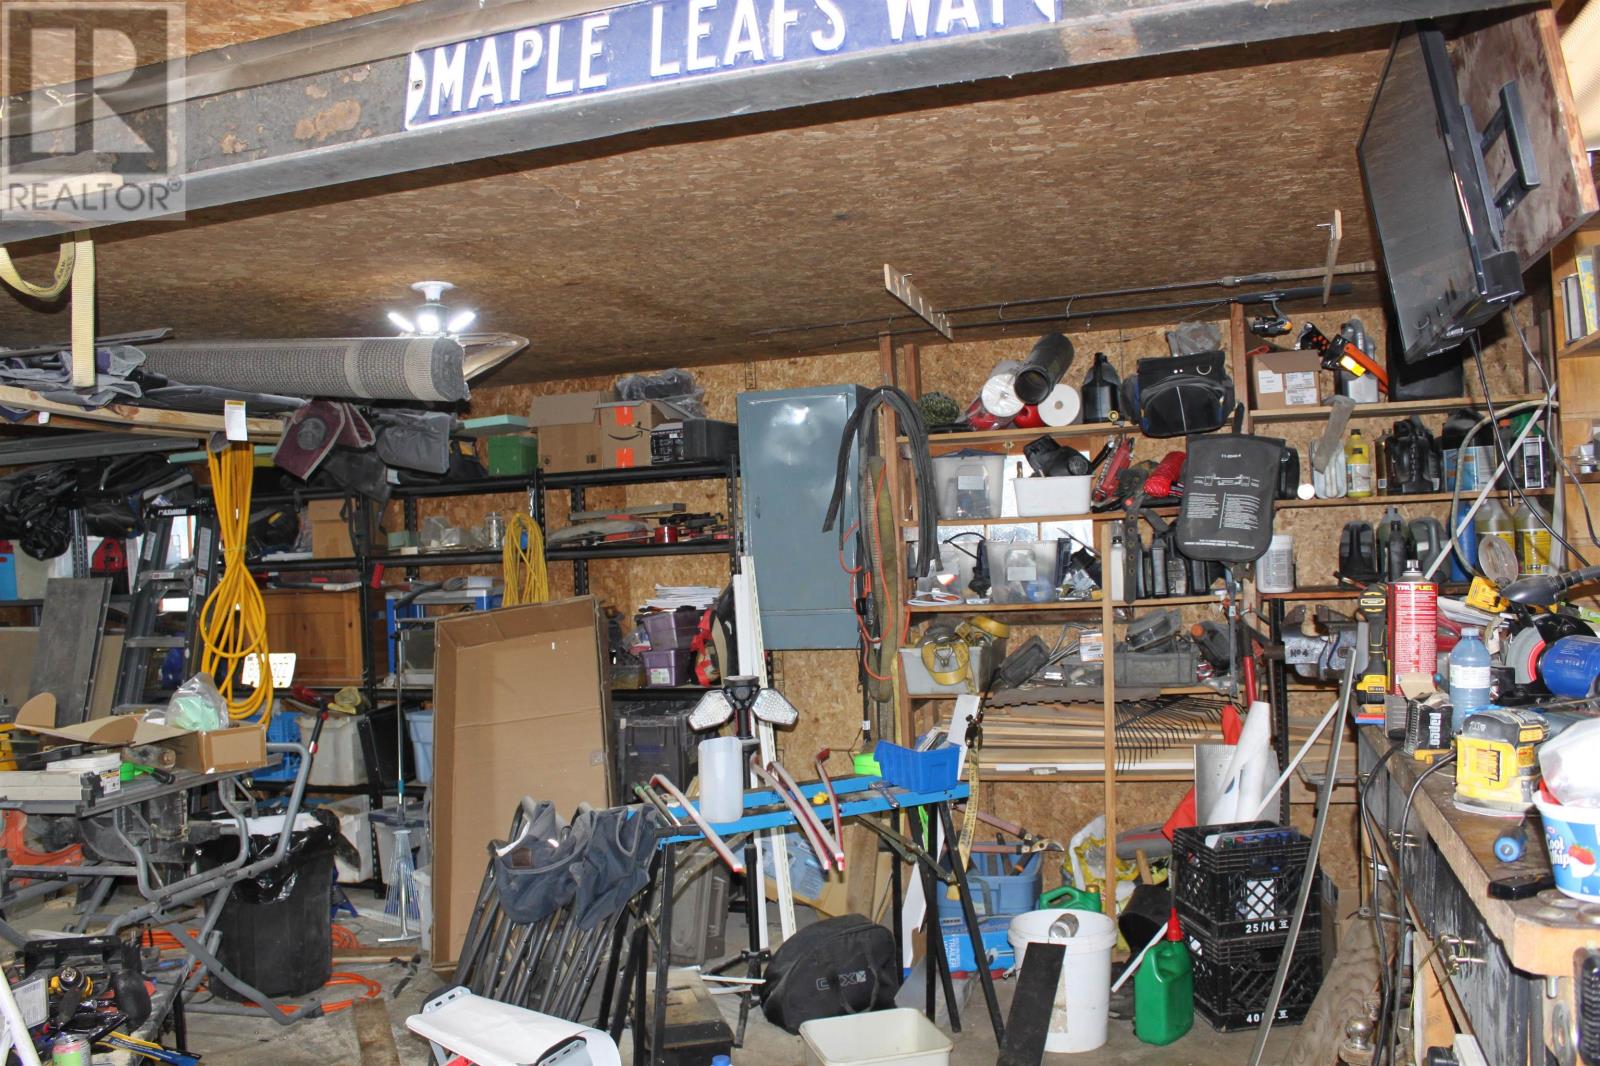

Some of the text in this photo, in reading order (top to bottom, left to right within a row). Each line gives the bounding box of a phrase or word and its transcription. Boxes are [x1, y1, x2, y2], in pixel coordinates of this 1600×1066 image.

[428, 13, 610, 117] MAPLE
[650, 0, 847, 77] LEAFS
[1245, 920, 1275, 933] 25/14
